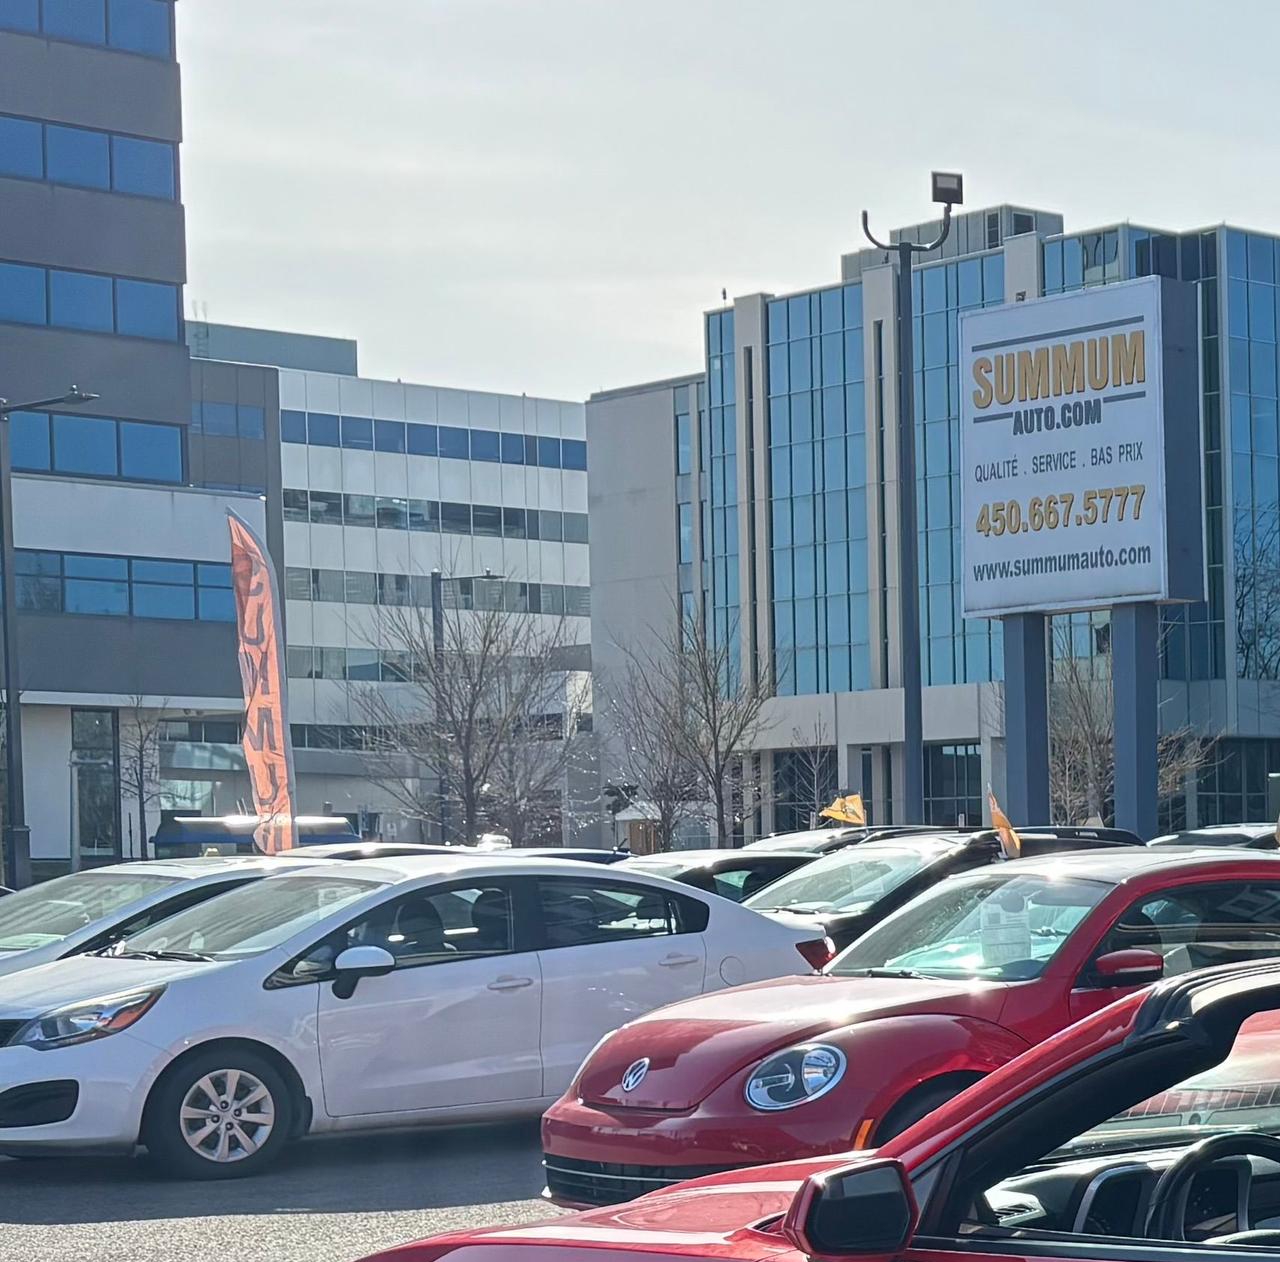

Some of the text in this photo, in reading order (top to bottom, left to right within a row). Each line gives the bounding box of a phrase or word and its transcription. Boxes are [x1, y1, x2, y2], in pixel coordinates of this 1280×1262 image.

[972, 330, 1146, 409] SUMMUM
[1012, 398, 1102, 436] AUTO.COM
[974, 441, 1144, 483] QUALITÉ SERVICE BAS PRIX
[975, 484, 1146, 538] 450.667.5777
[972, 544, 1152, 582] www.summumauto.com
